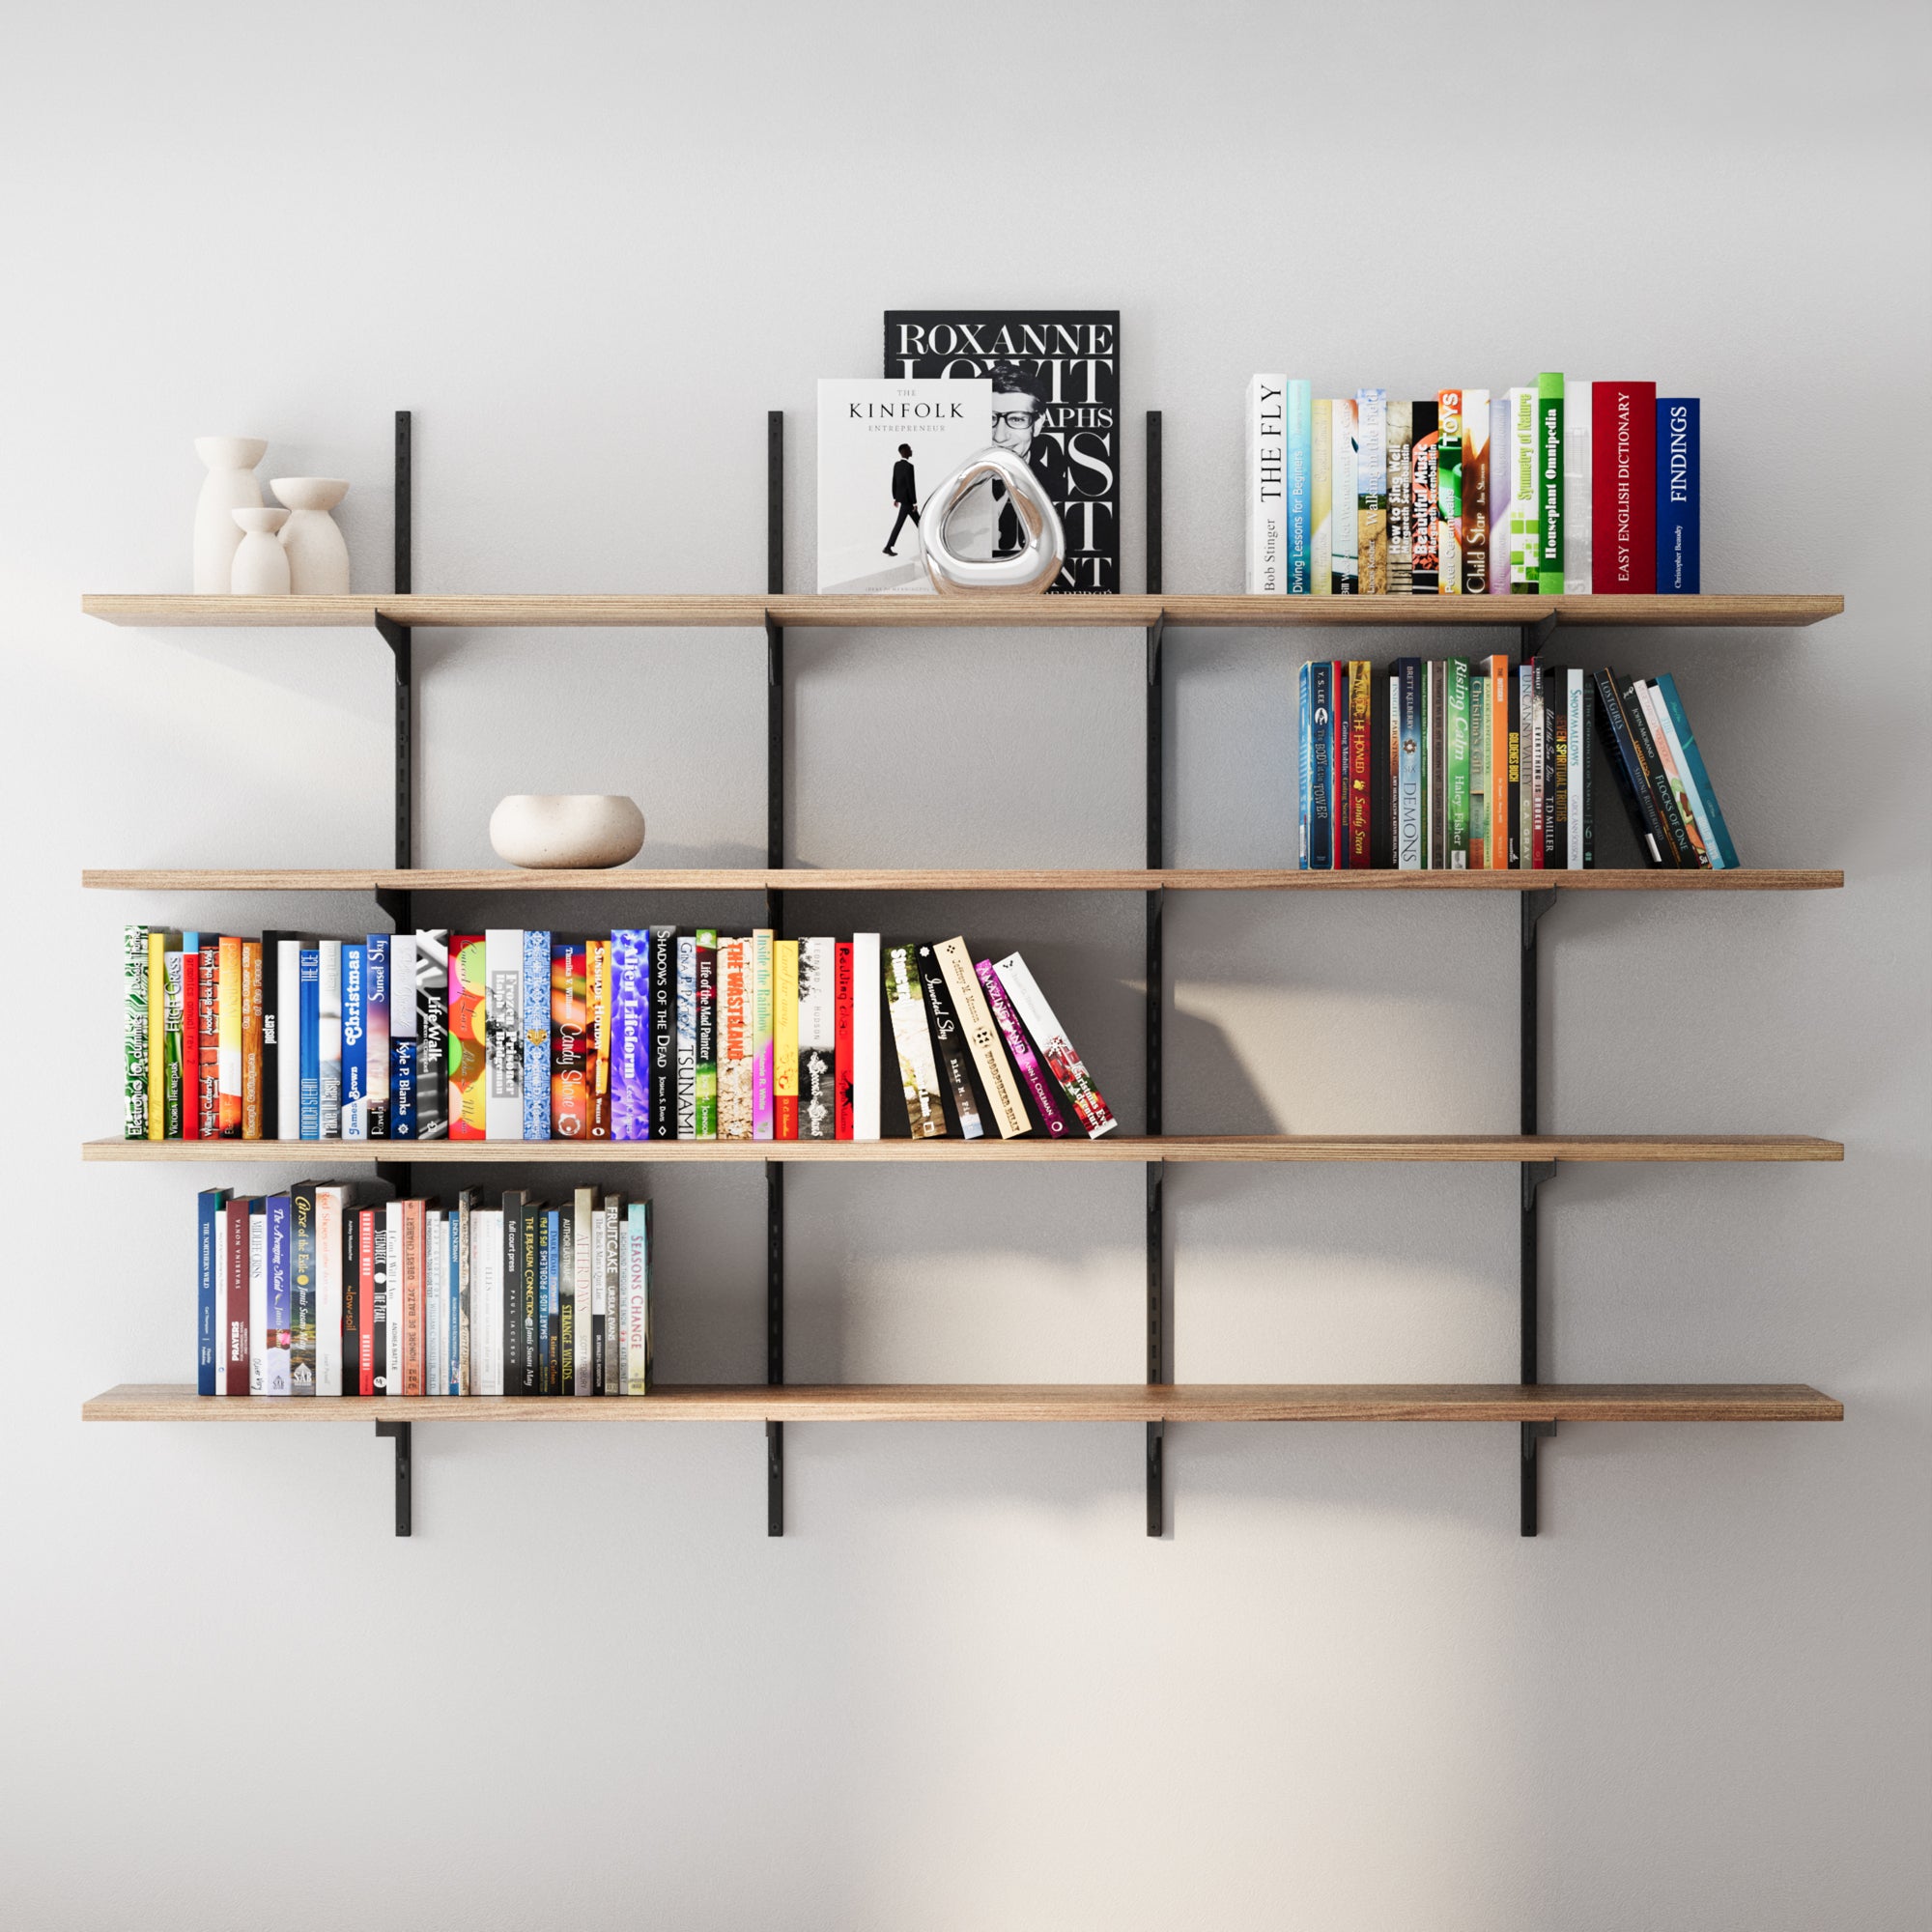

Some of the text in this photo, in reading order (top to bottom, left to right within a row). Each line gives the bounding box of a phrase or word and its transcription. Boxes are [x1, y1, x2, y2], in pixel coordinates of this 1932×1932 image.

[896, 324, 1113, 355] ROXANNE
[849, 403, 964, 418] KINFOLK
[1261, 384, 1281, 502] THE FLY
[1442, 393, 1458, 446] TOYS
[1518, 394, 1533, 499] Symmetry of Nature
[1366, 393, 1380, 525] Walking in the Field
[1546, 409, 1560, 558] Houseplant Omnipedia
[1618, 392, 1630, 582] EASY ENGLISH DICTIONARY
[1670, 406, 1687, 502] FINDINGS
[1293, 450, 1305, 593] Diving Lessons for Beginers
[1389, 445, 1403, 554] How to Sing Well
[1414, 444, 1428, 554] Beautiful Music
[1264, 519, 1278, 590] Bob Stinger
[1466, 513, 1486, 594] Child Star
[1674, 552, 1683, 588] Christopher
[1449, 660, 1468, 760] Rising Calm
[1521, 673, 1532, 787] UNCANNY VALLEY
[1632, 708, 1655, 758] JOHN MORANO
[1509, 765, 1519, 781] BUCH
[1535, 783, 1542, 793] IS
[1556, 715, 1566, 822] SEVEN SPIRITUAL TRUTHS
[1353, 796, 1366, 855] Sandy Steen
[1402, 782, 1417, 863] DEMONS
[1454, 776, 1463, 845] Haley Fisher
[1655, 775, 1689, 851] FLOCKS OF ONE
[301, 955, 318, 981] THE ICE
[345, 951, 362, 1045] Christmas
[368, 940, 386, 1002] Sunset Sky
[457, 987, 476, 1001] of
[727, 943, 743, 1060] THE WASTELAND
[757, 935, 770, 1033] Inside the Rainbow
[263, 1015, 277, 1043] posters
[429, 997, 441, 1062] Life Walk
[496, 975, 505, 1094] Ralph Bridgeman
[506, 974, 517, 1094] Frozen Prisoner
[624, 944, 638, 1078] Alien Lifeform
[658, 990, 668, 1030] OF THE
[701, 961, 711, 1060] Life of the Mad Painter
[925, 974, 954, 1040] Inverted Sky
[128, 1014, 143, 1136] Electronics for dummies
[321, 1078, 340, 1100] Easy!
[397, 1042, 410, 1115] Kyle P. Blanks
[556, 1023, 582, 1108] Candy Shore
[678, 1045, 694, 1134] TSUNAMI
[301, 1107, 318, 1136] MONICA
[322, 1114, 338, 1135] Take
[251, 1220, 263, 1278] MIDLIFE CRISIS
[272, 1208, 284, 1292] The Avenging Maid
[296, 1196, 311, 1273] Curse of the Exile
[322, 1192, 330, 1239] Red Shoes
[375, 1230, 385, 1264] STEINBECK
[608, 1207, 617, 1273] FRUITCAKE
[577, 1234, 589, 1312] AFTER DAYS
[298, 1286, 307, 1350] Janis Susan May
[562, 1305, 572, 1379] STRANGE WINDS
[525, 1369, 533, 1386] May
